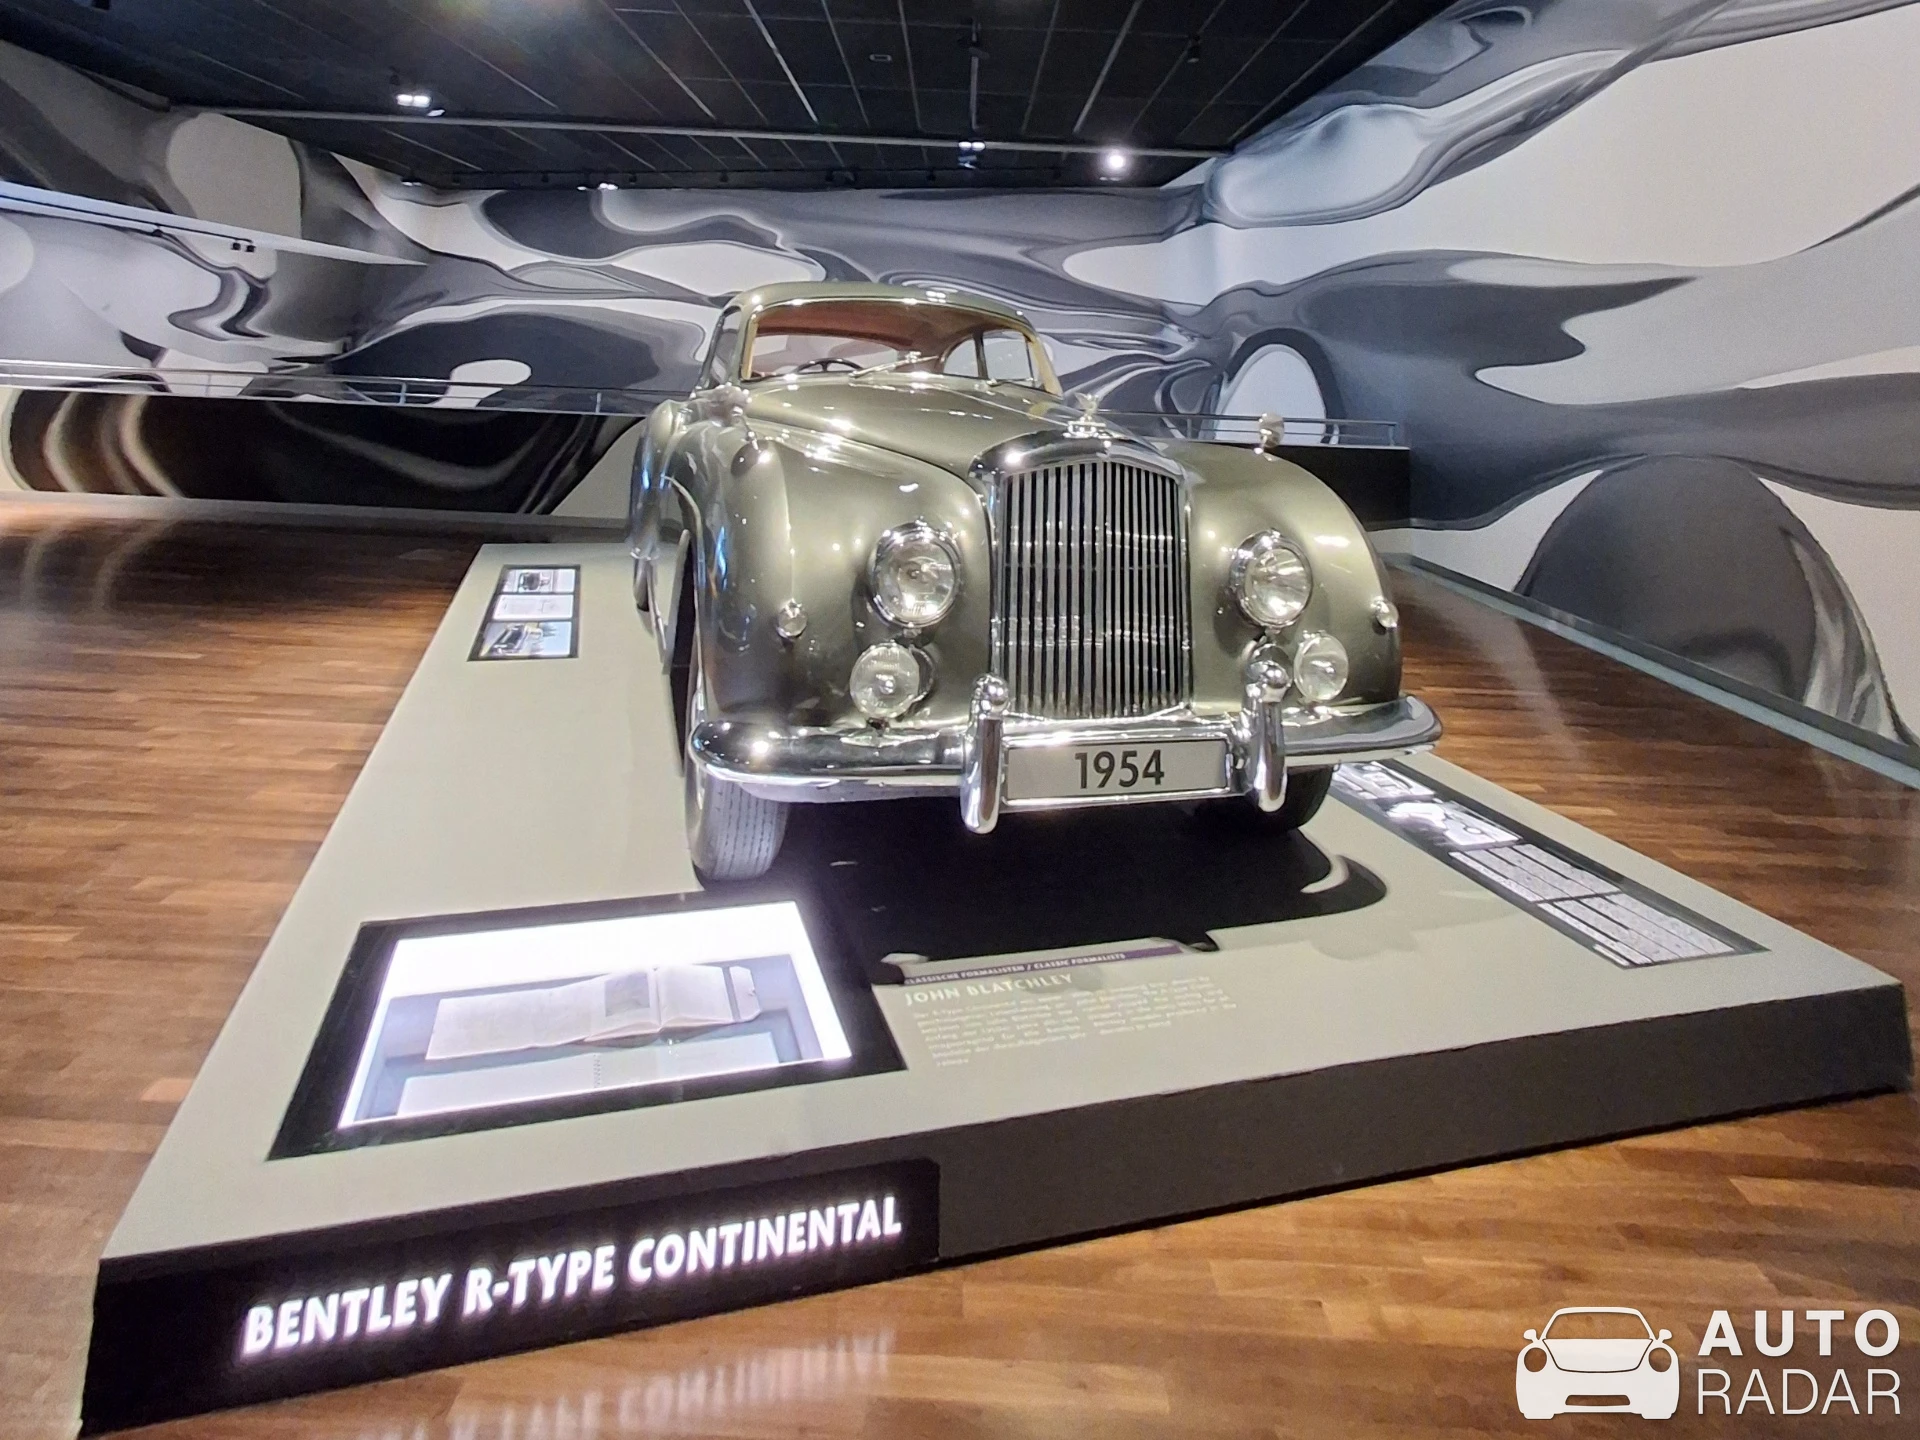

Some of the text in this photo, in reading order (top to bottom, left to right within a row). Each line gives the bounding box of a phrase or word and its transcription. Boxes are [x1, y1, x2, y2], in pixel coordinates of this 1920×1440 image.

[1075, 749, 1165, 789] 1954
[1034, 959, 1069, 970] CLASSIC
[905, 974, 1072, 1007] JOHN BLATCHLEY
[243, 1196, 902, 1355] BENTLEY R-TYPE CONTINENTAL
